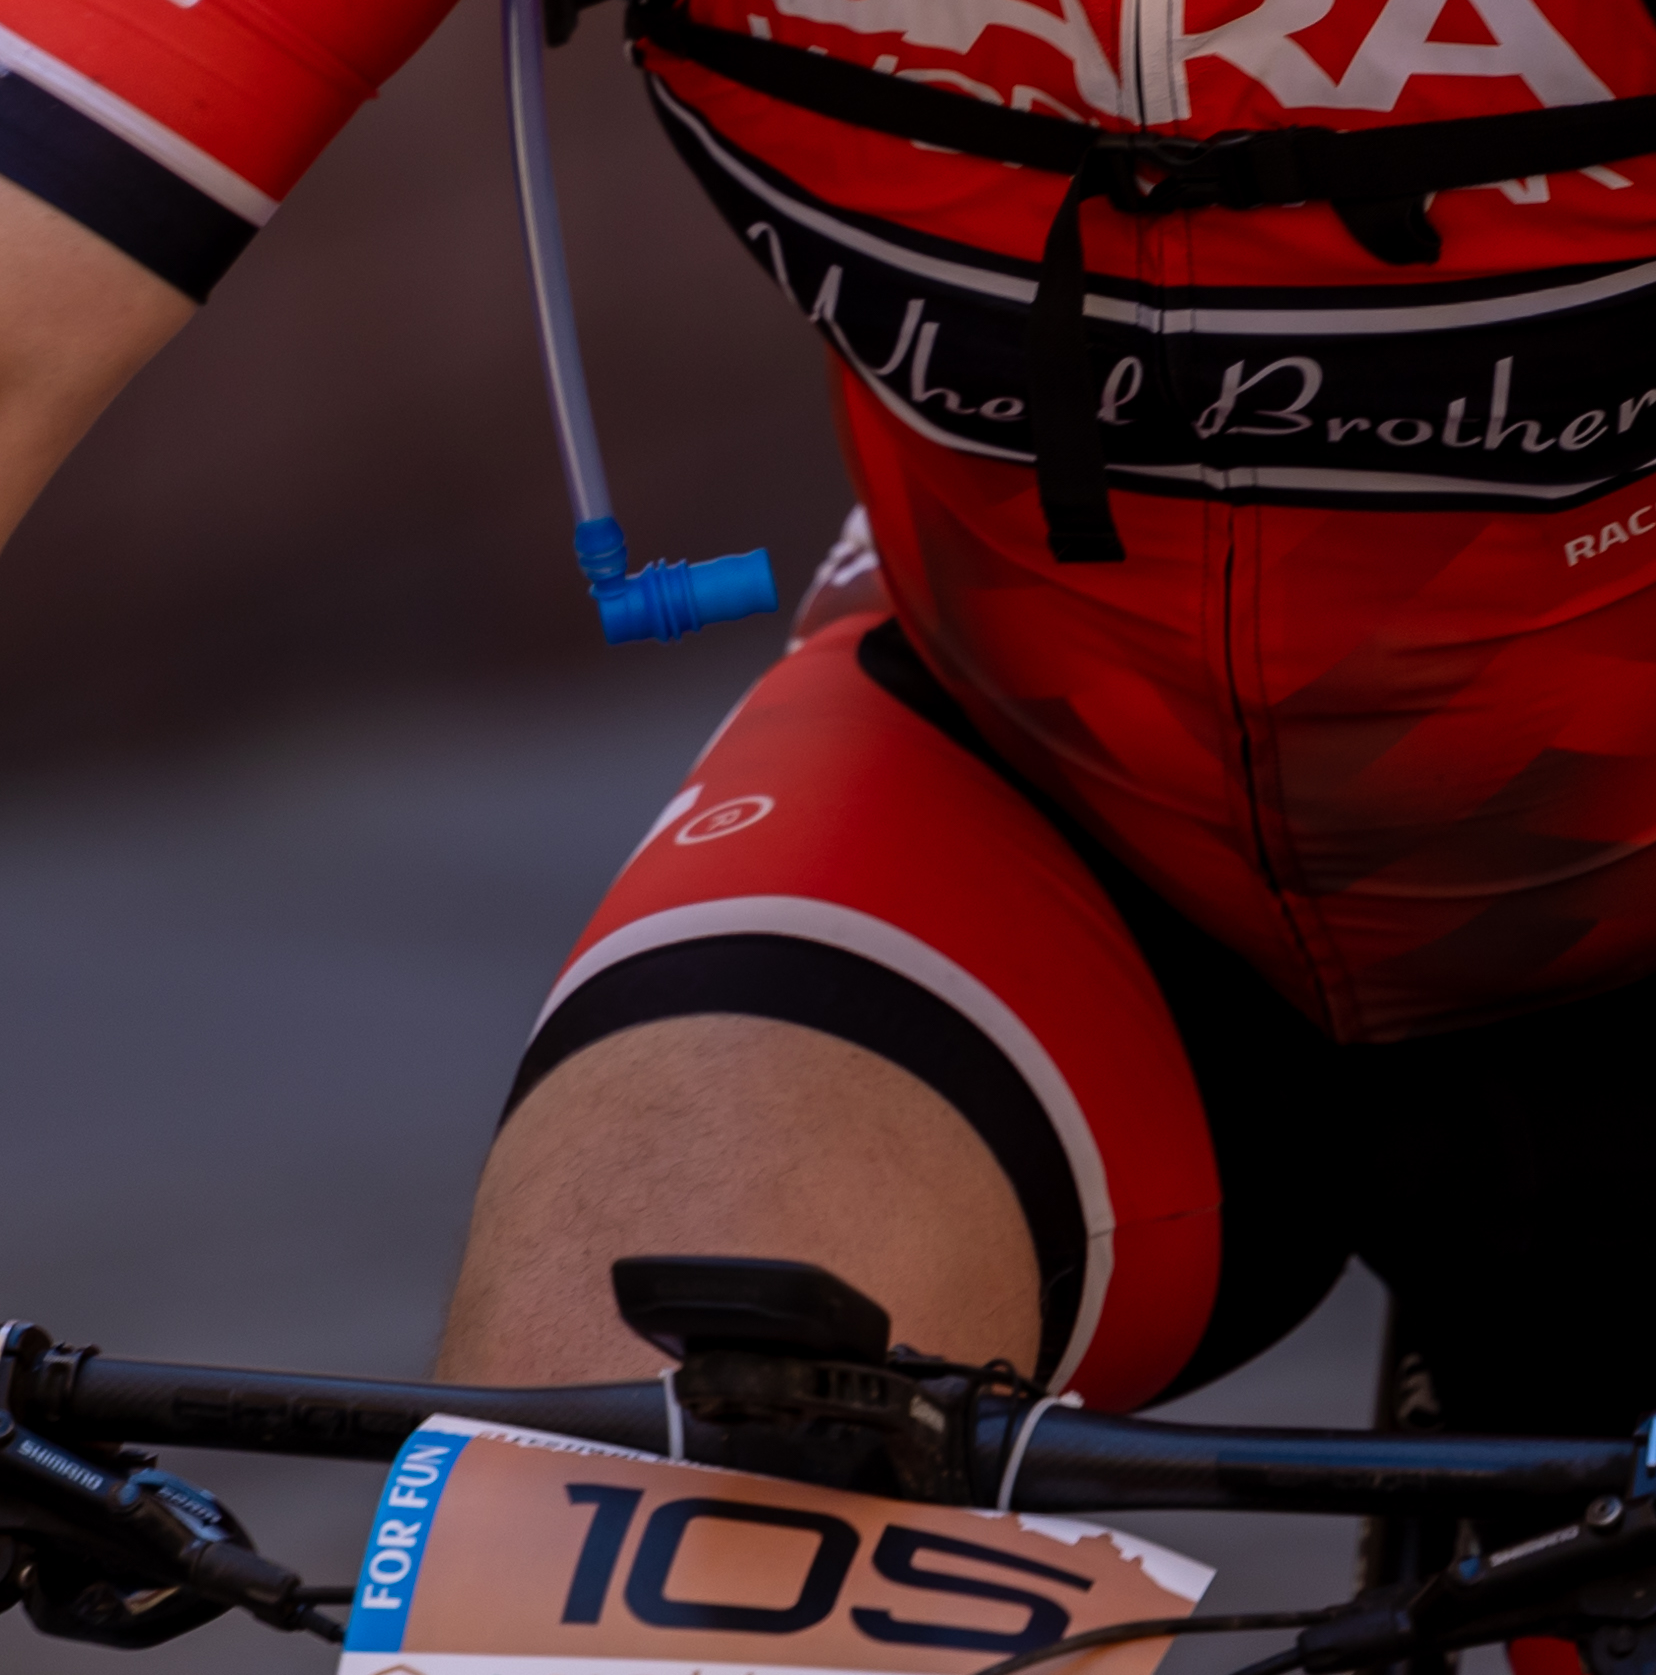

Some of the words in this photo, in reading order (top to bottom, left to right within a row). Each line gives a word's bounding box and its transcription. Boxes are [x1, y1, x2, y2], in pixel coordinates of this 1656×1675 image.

[747, 221, 1144, 425] Whel
[18, 1439, 104, 1492] SHIMANO
[387, 1444, 452, 1510] FUN
[360, 1519, 422, 1610] FOR
[560, 1482, 1095, 1657] 105
